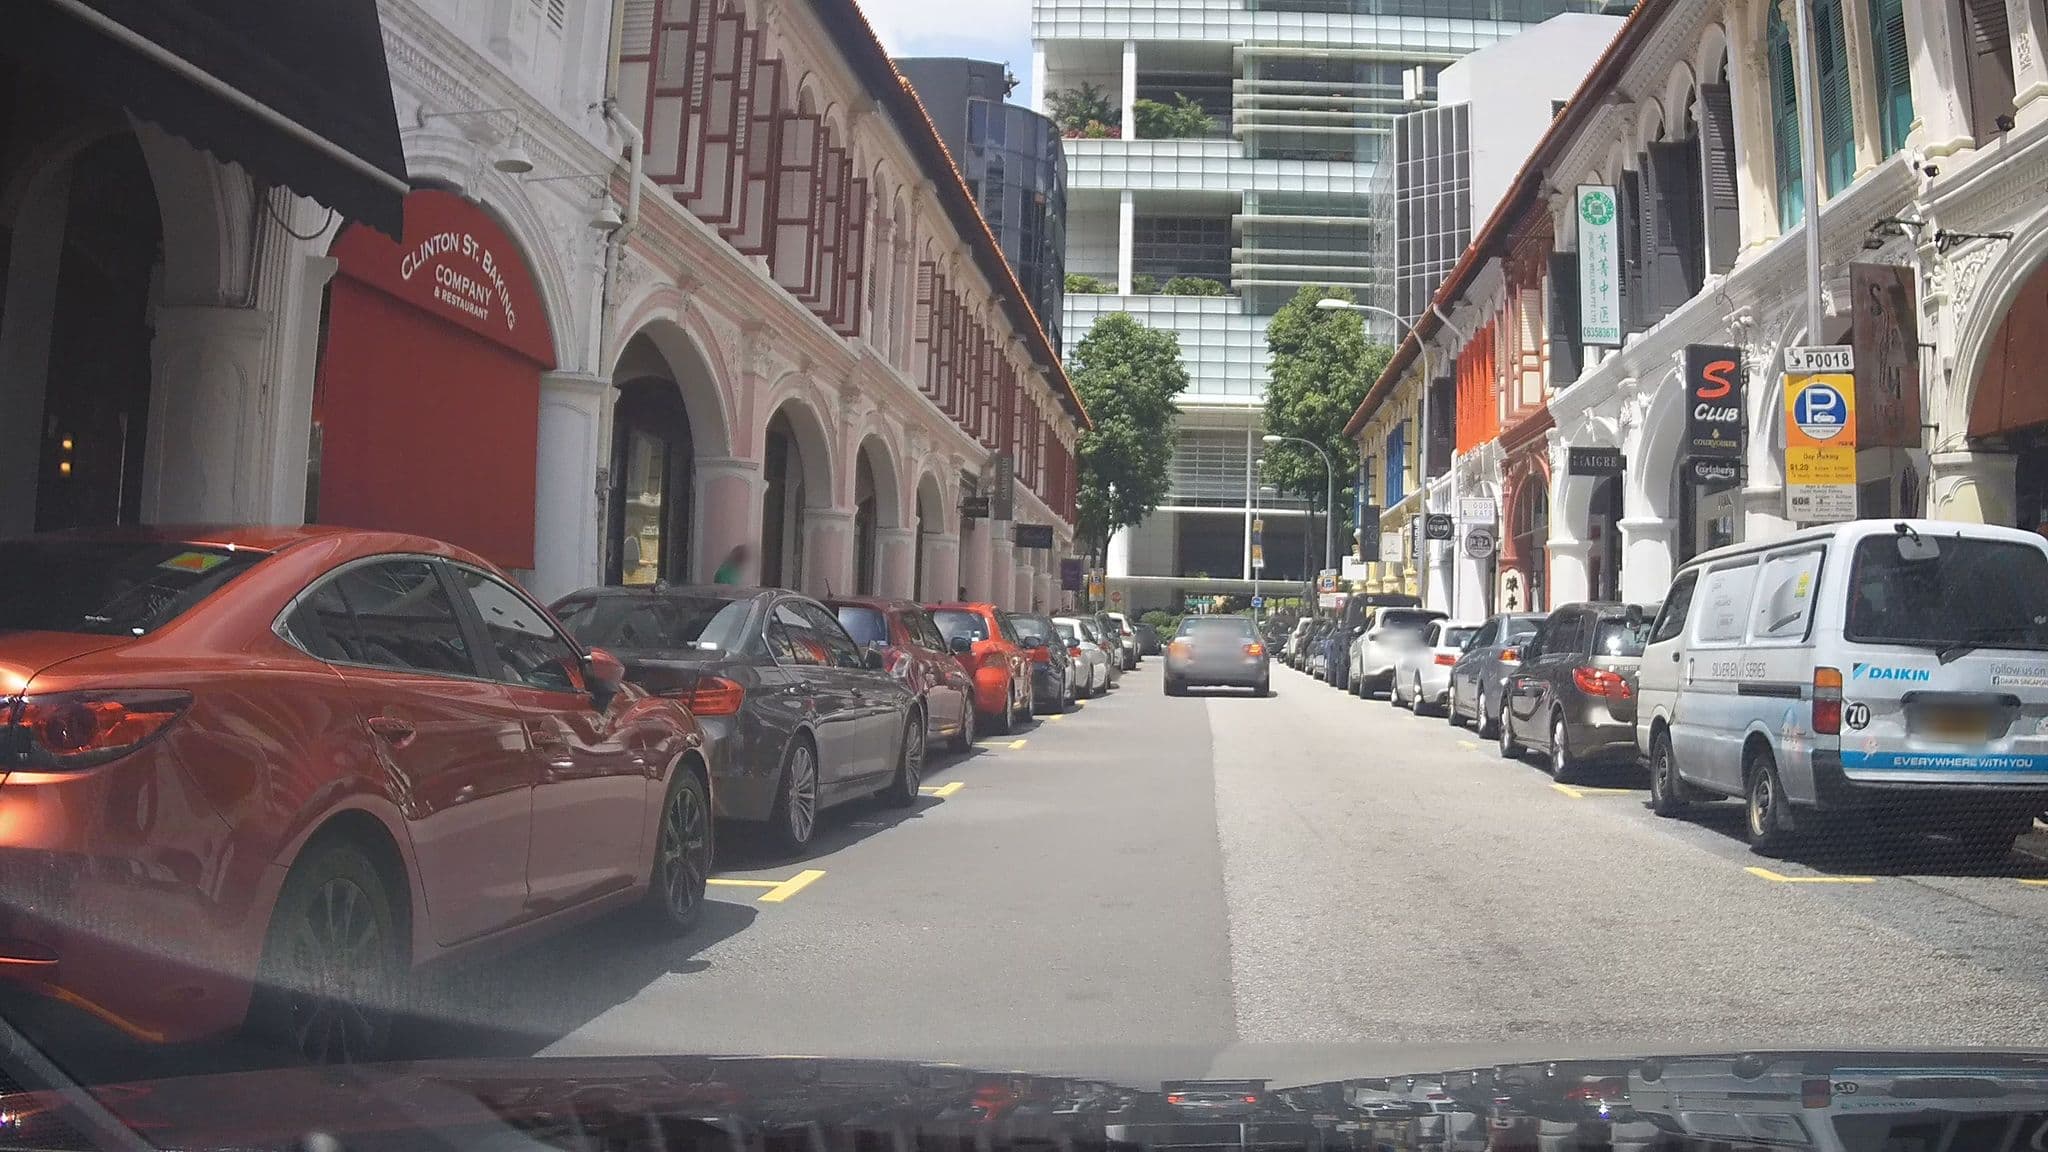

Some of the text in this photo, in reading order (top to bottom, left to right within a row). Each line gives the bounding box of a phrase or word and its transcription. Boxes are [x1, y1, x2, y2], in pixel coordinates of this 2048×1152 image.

[401, 233, 516, 331] CLINTON ST. BAKING
[435, 264, 492, 306] COMPANY
[434, 286, 489, 320] & RESTAURANT
[1805, 353, 1849, 368] P0018
[1696, 360, 1736, 398] S
[1694, 403, 1738, 421] CLUB
[1805, 388, 1837, 424] P
[1868, 667, 1930, 681] DAIKIN
[1850, 705, 1867, 723] 70
[1893, 756, 2033, 768] EVERYWHERE WITH YOU
